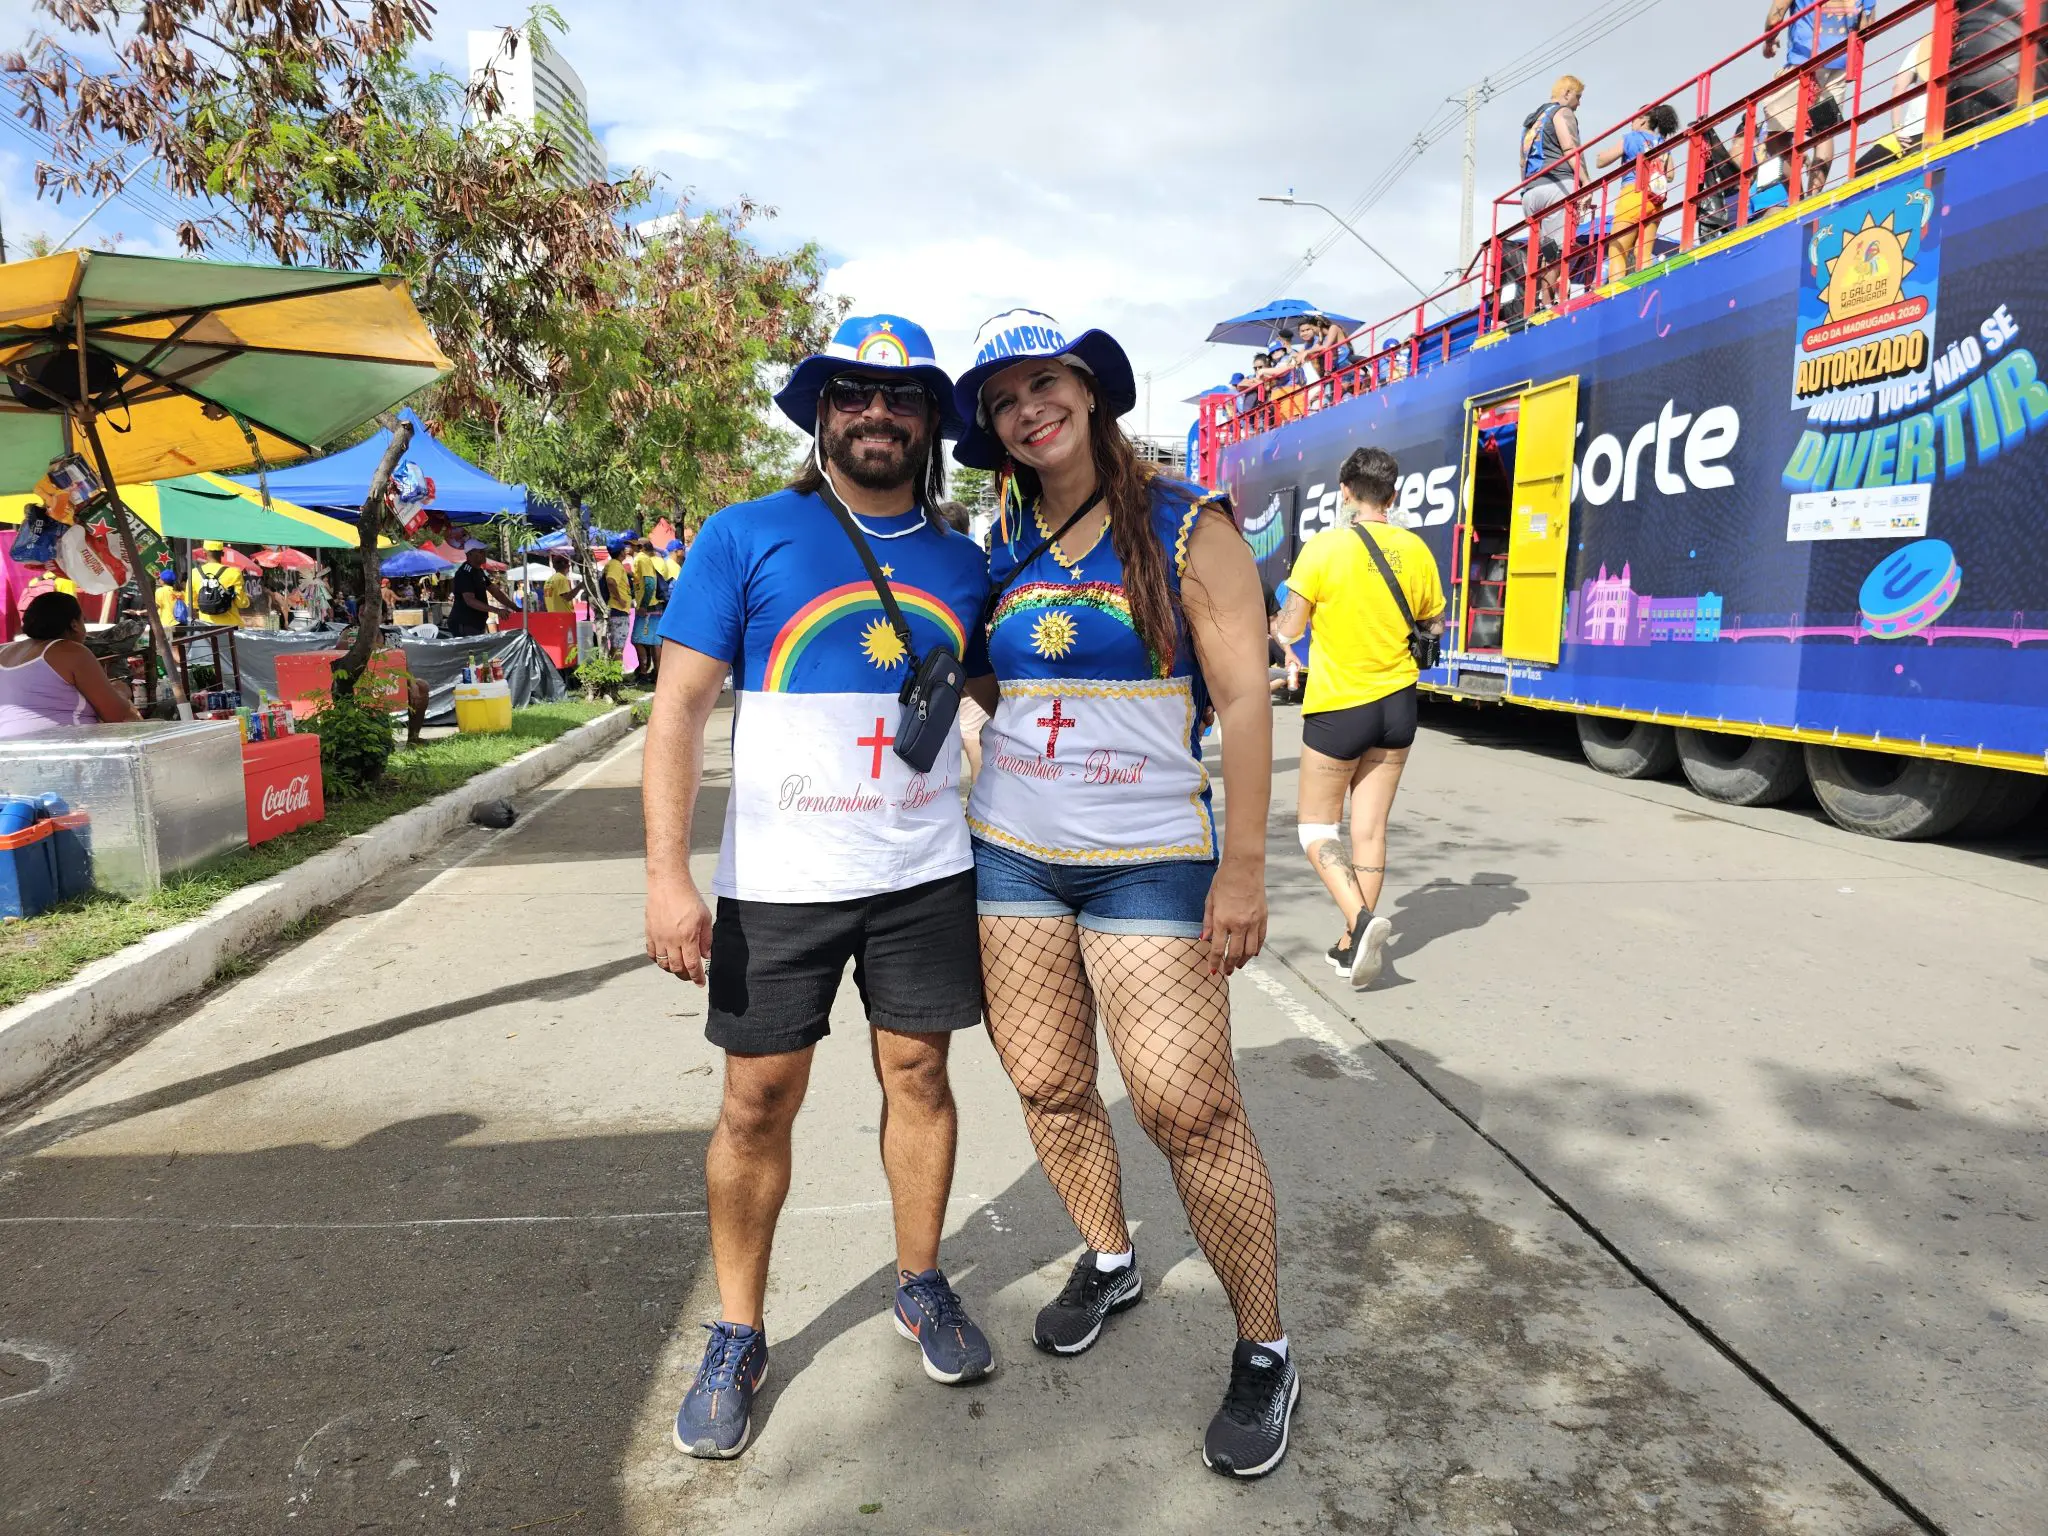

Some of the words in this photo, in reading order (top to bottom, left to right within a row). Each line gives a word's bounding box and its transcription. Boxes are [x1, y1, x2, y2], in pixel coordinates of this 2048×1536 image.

[1841, 288, 1888, 310] MADRUGADA
[1849, 283, 1873, 299] GALO
[1875, 278, 1888, 291] DA
[975, 325, 1067, 367] RNAMBUCO
[1806, 330, 1829, 346] GALO
[1829, 326, 1842, 340] DA
[1842, 312, 1897, 337] MADRUGADA
[1897, 303, 1922, 322] 2026
[1795, 329, 1928, 397] AUTORIZADO
[1932, 335, 1982, 392] NÃO
[1980, 303, 2020, 352] SE
[1784, 348, 2048, 490] DIVERTIR
[1571, 398, 1740, 507] orte
[1083, 749, 1149, 784] Brasil
[261, 774, 311, 821] Coca-Cola
[778, 774, 885, 813] Pernambuco
